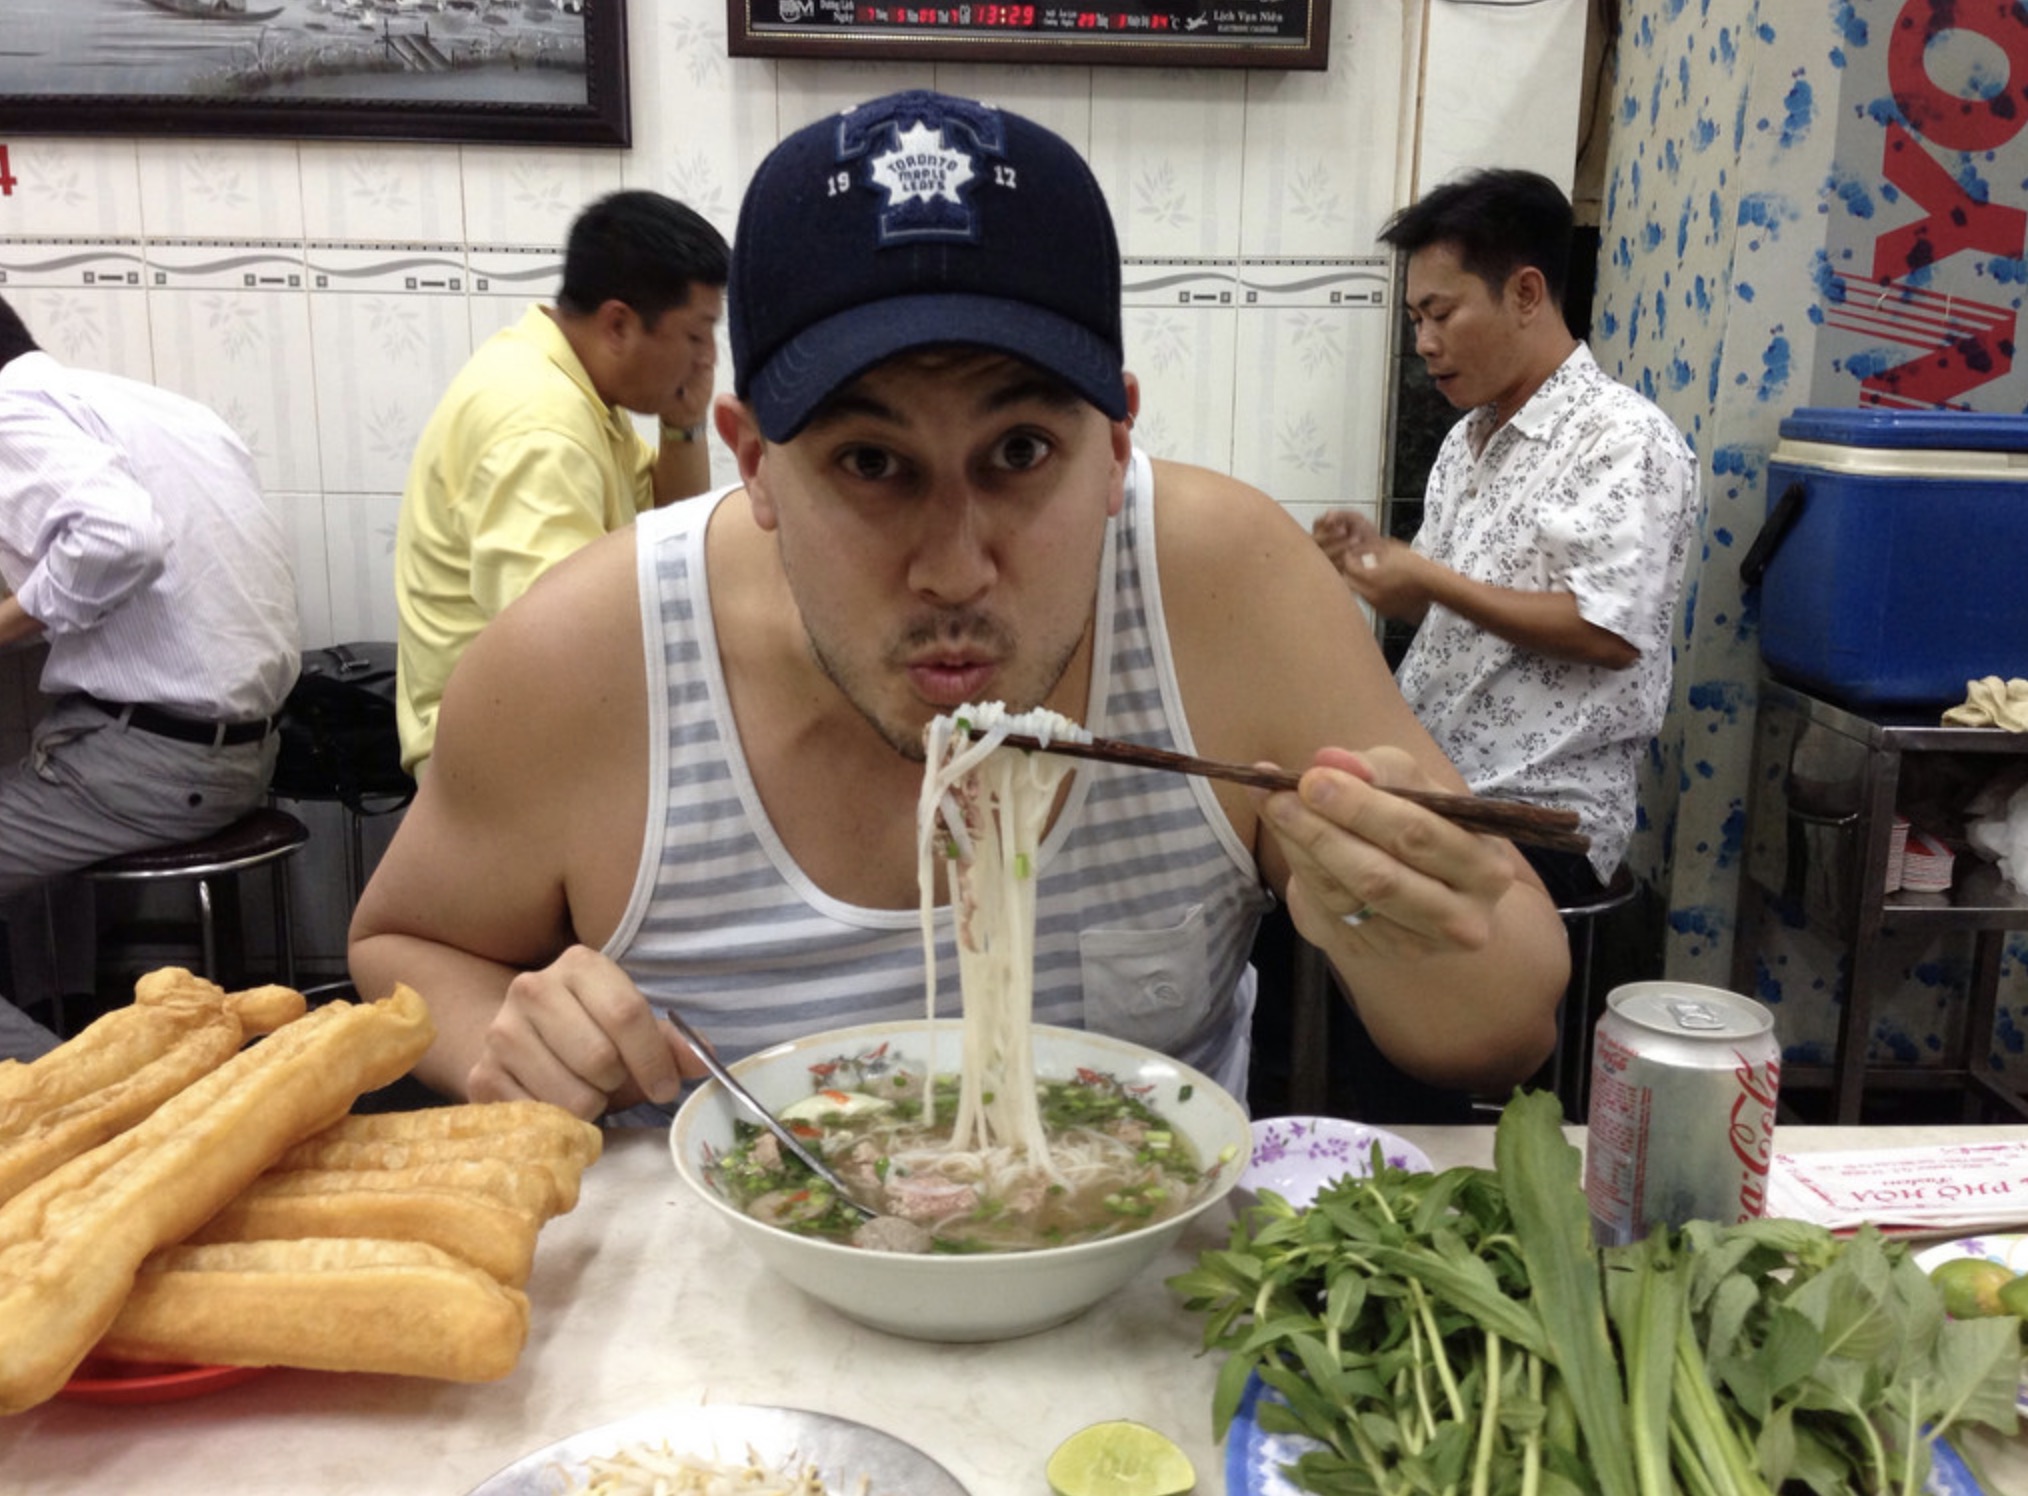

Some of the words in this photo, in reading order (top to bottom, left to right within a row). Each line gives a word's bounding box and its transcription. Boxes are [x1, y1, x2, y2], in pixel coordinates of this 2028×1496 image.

[979, 5, 1034, 25] 13:29
[887, 154, 958, 173] TORONTO
[827, 171, 850, 197] 19
[899, 168, 947, 181] MAPLE
[902, 180, 946, 192] LEAFS
